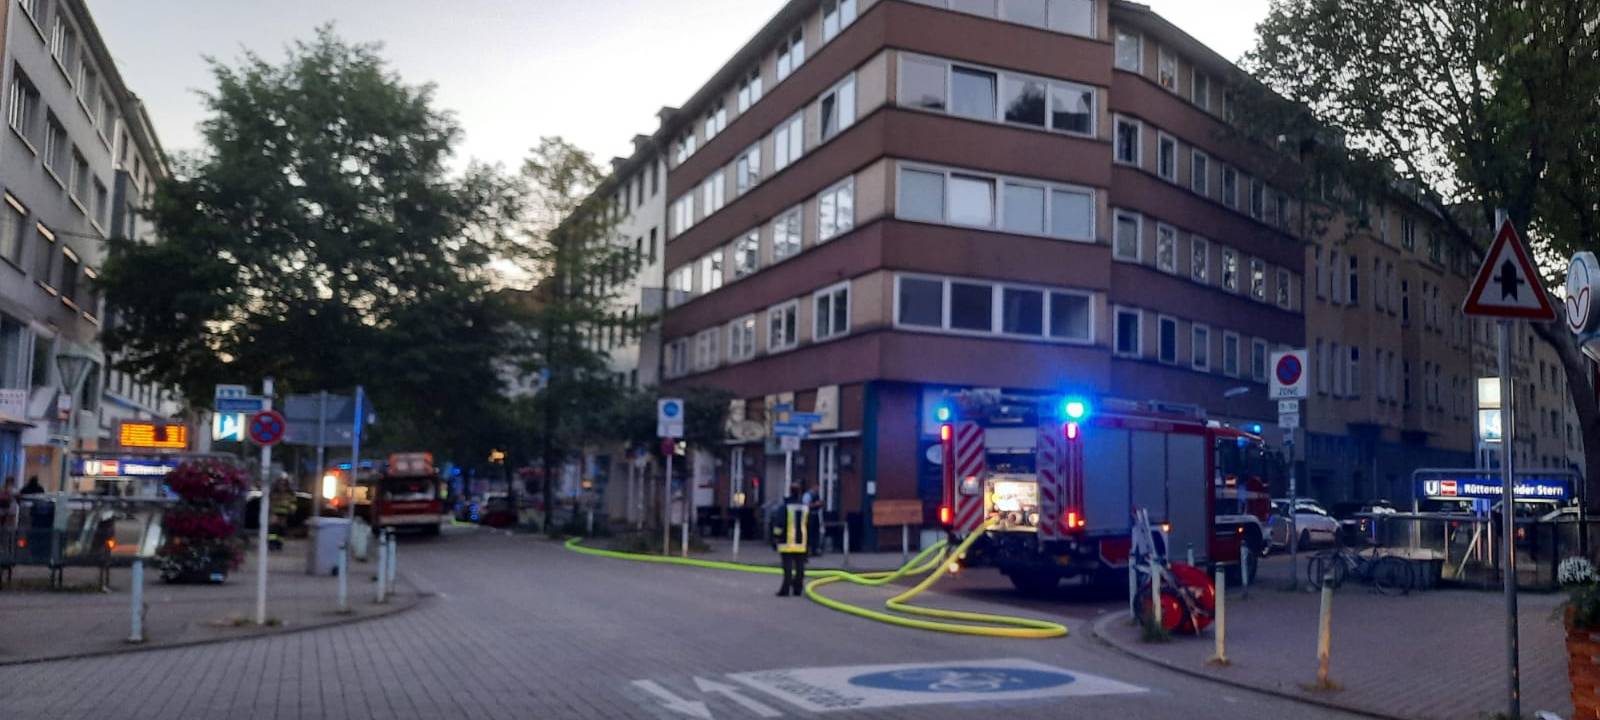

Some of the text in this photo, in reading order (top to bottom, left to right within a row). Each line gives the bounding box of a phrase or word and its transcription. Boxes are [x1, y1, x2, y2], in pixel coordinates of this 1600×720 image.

[1425, 480, 1438, 494] U
[1464, 484, 1535, 495] Rüttenscider
[1537, 485, 1563, 495] Stern
